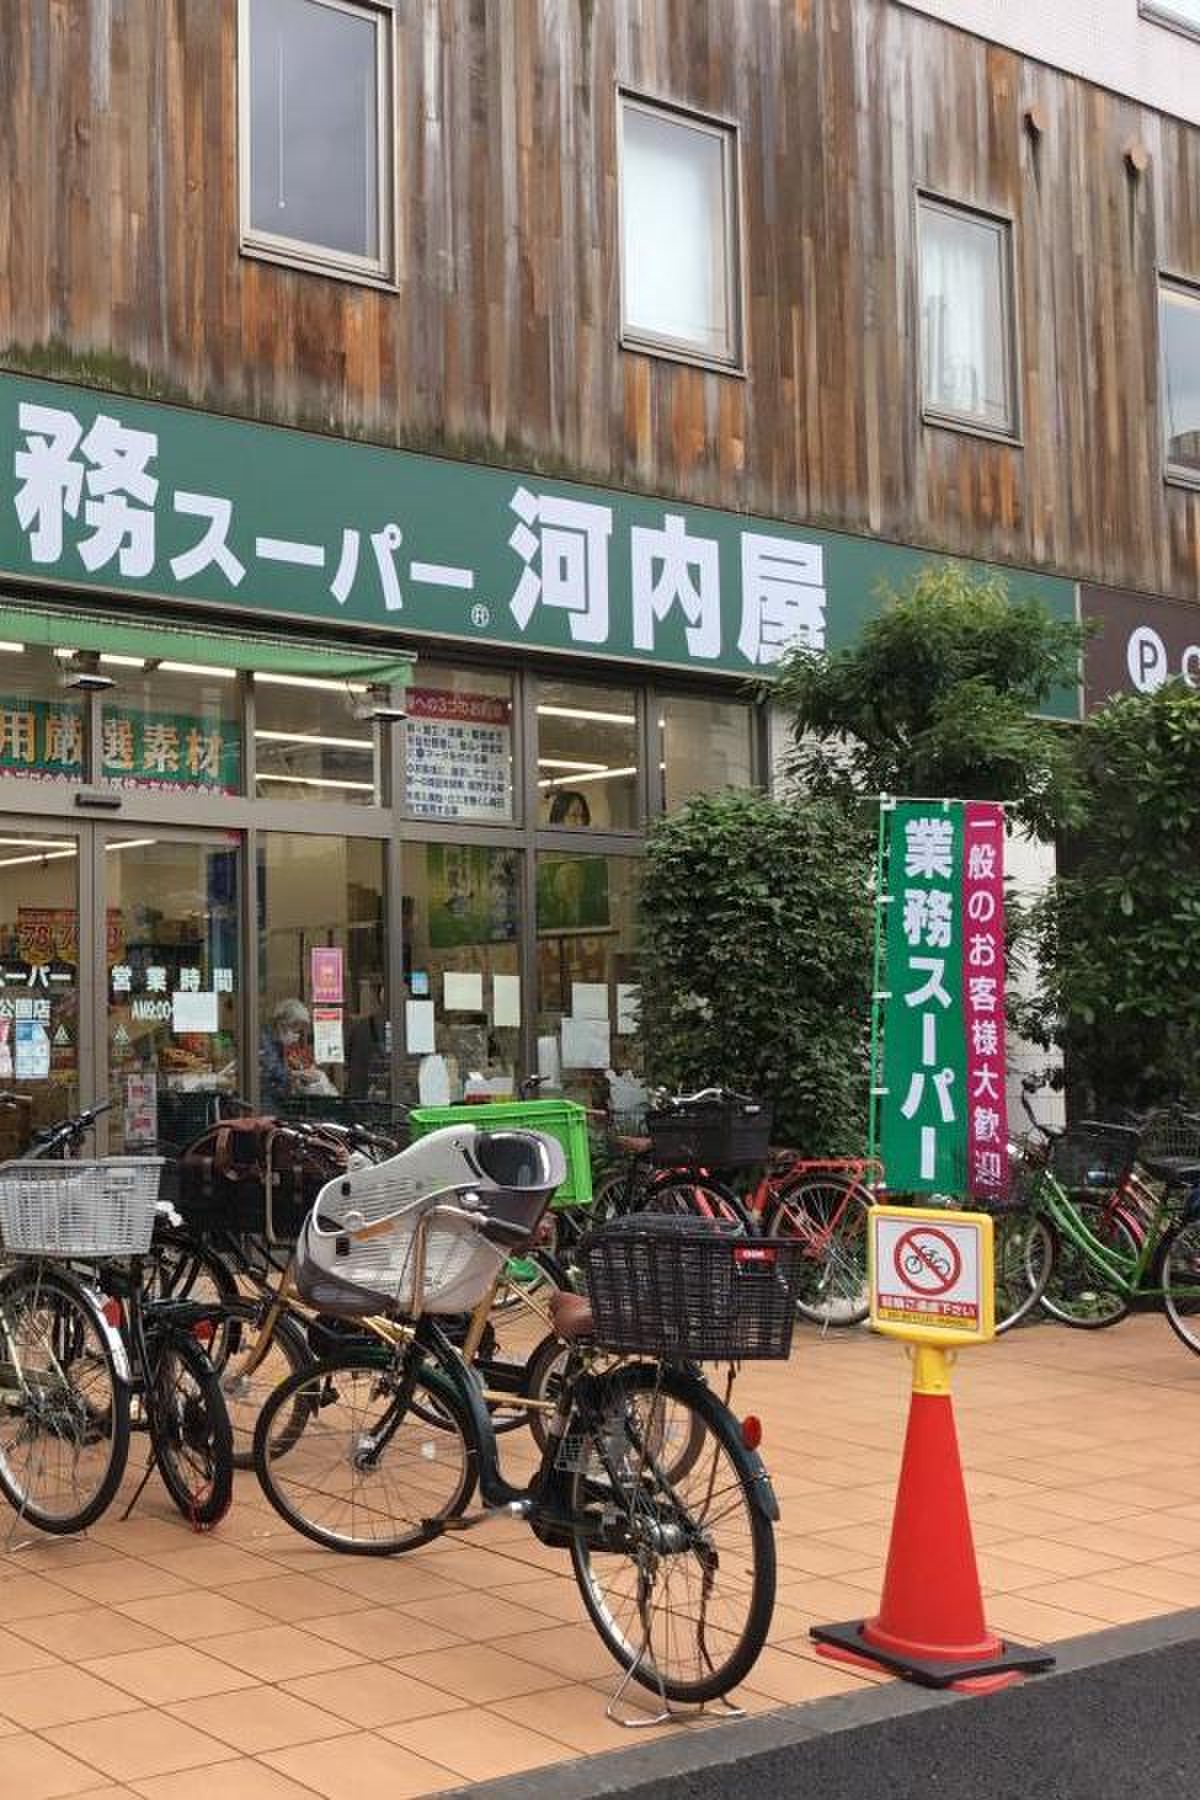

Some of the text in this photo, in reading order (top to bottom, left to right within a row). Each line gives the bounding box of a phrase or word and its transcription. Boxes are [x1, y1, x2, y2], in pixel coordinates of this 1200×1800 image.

[508, 486, 828, 664] 河内屋
[111, 964, 233, 993] 営業時間
[901, 818, 955, 1180] 業務スーパー
[968, 819, 1002, 1186] 一般のお客様大歓迎
